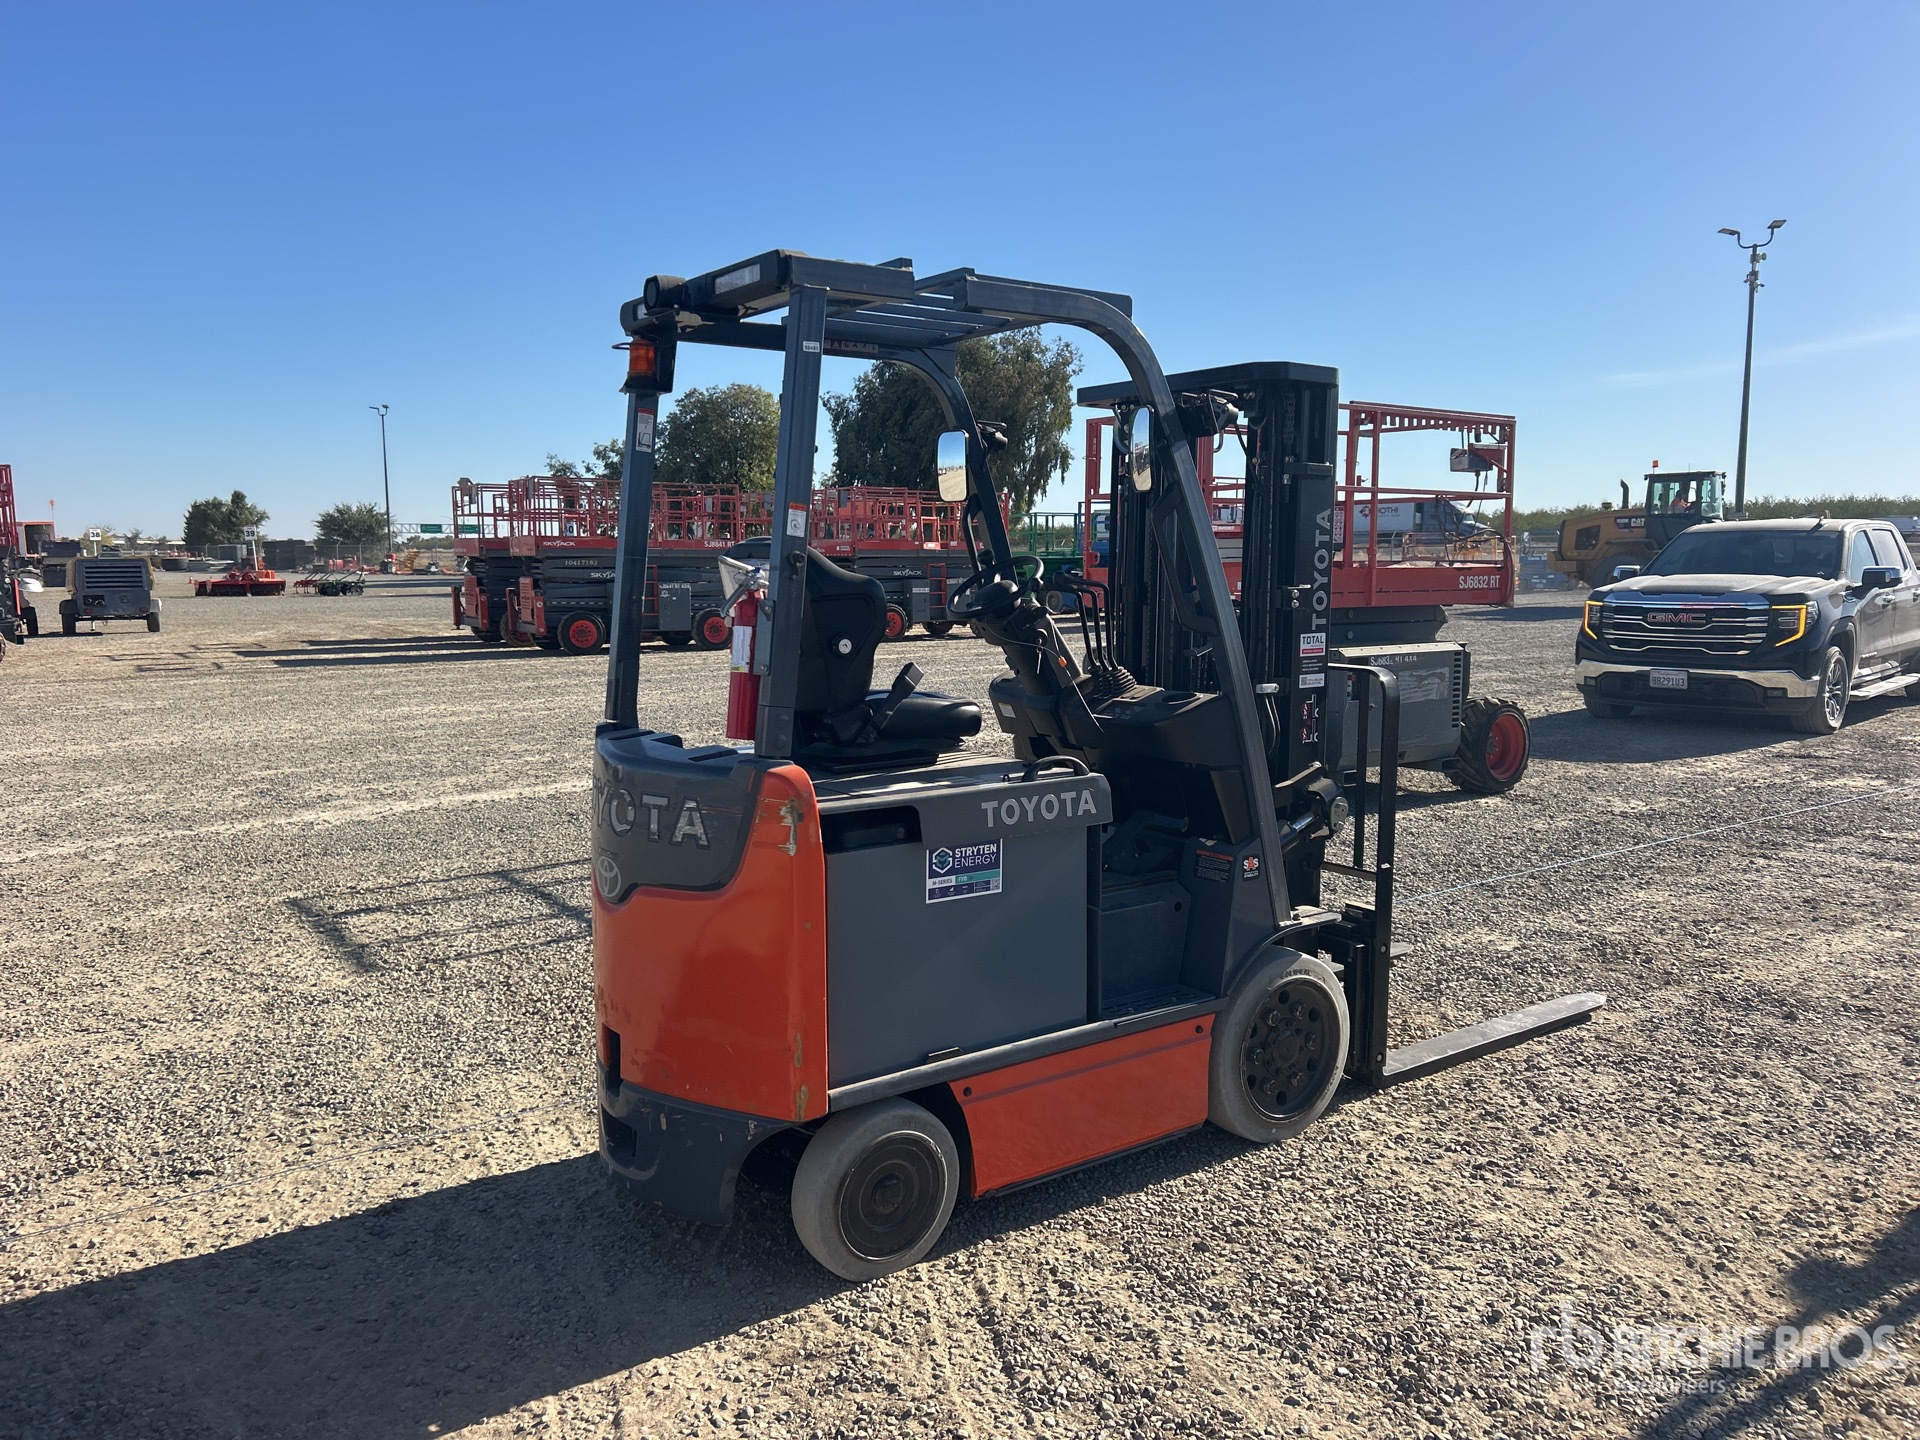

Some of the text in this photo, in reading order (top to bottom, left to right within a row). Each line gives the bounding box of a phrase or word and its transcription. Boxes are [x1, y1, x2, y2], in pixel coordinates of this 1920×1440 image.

[1631, 518, 1645, 527] CAT
[590, 570, 616, 579] SKYJA
[893, 568, 922, 577] SKYJACK
[1312, 508, 1331, 630] TOYOTA
[1459, 575, 1501, 589] SJ6832 RT
[1647, 612, 1706, 624] GMC
[1301, 635, 1324, 645] TOTAL
[1652, 676, 1685, 687] 88291U3
[981, 789, 1097, 828] TOYOTA
[955, 843, 997, 858] STRYTEN
[954, 853, 997, 869] ENERGY
[932, 878, 953, 886] M-SERIES
